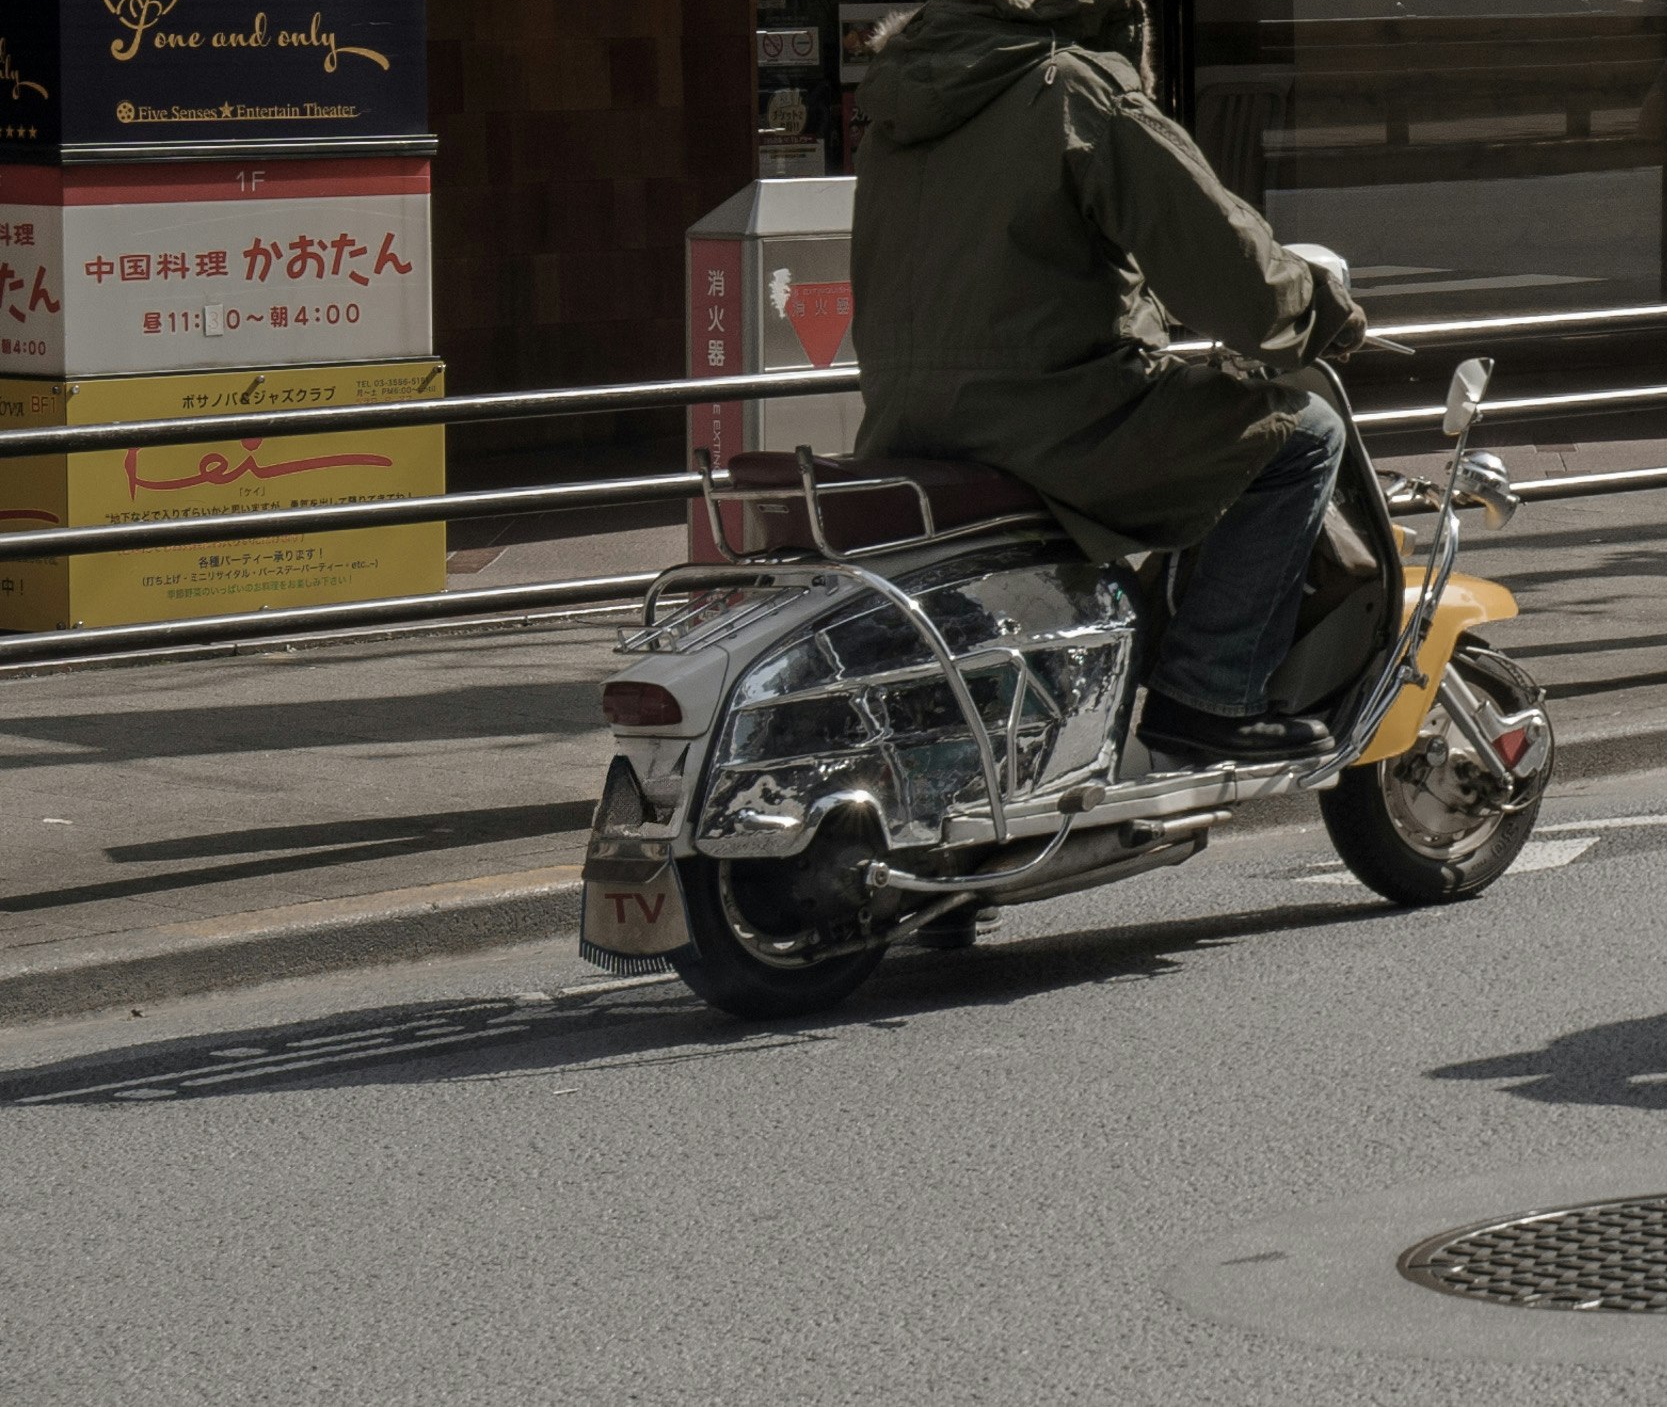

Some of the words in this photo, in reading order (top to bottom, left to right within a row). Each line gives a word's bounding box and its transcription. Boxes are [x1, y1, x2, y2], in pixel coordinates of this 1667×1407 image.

[154, 31, 204, 48] one
[212, 12, 271, 47] and
[277, 12, 390, 73] only
[138, 106, 168, 120] Five
[172, 105, 217, 119] Senses
[236, 103, 300, 118] Entertain
[304, 102, 356, 117] Theater
[236, 171, 266, 192] 1F
[85, 250, 229, 284] 中国料理
[242, 232, 413, 286] かおたん
[707, 269, 725, 367] 消火器
[356, 380, 371, 388] TEL
[31, 396, 57, 414] BF1
[604, 893, 666, 924] TV
